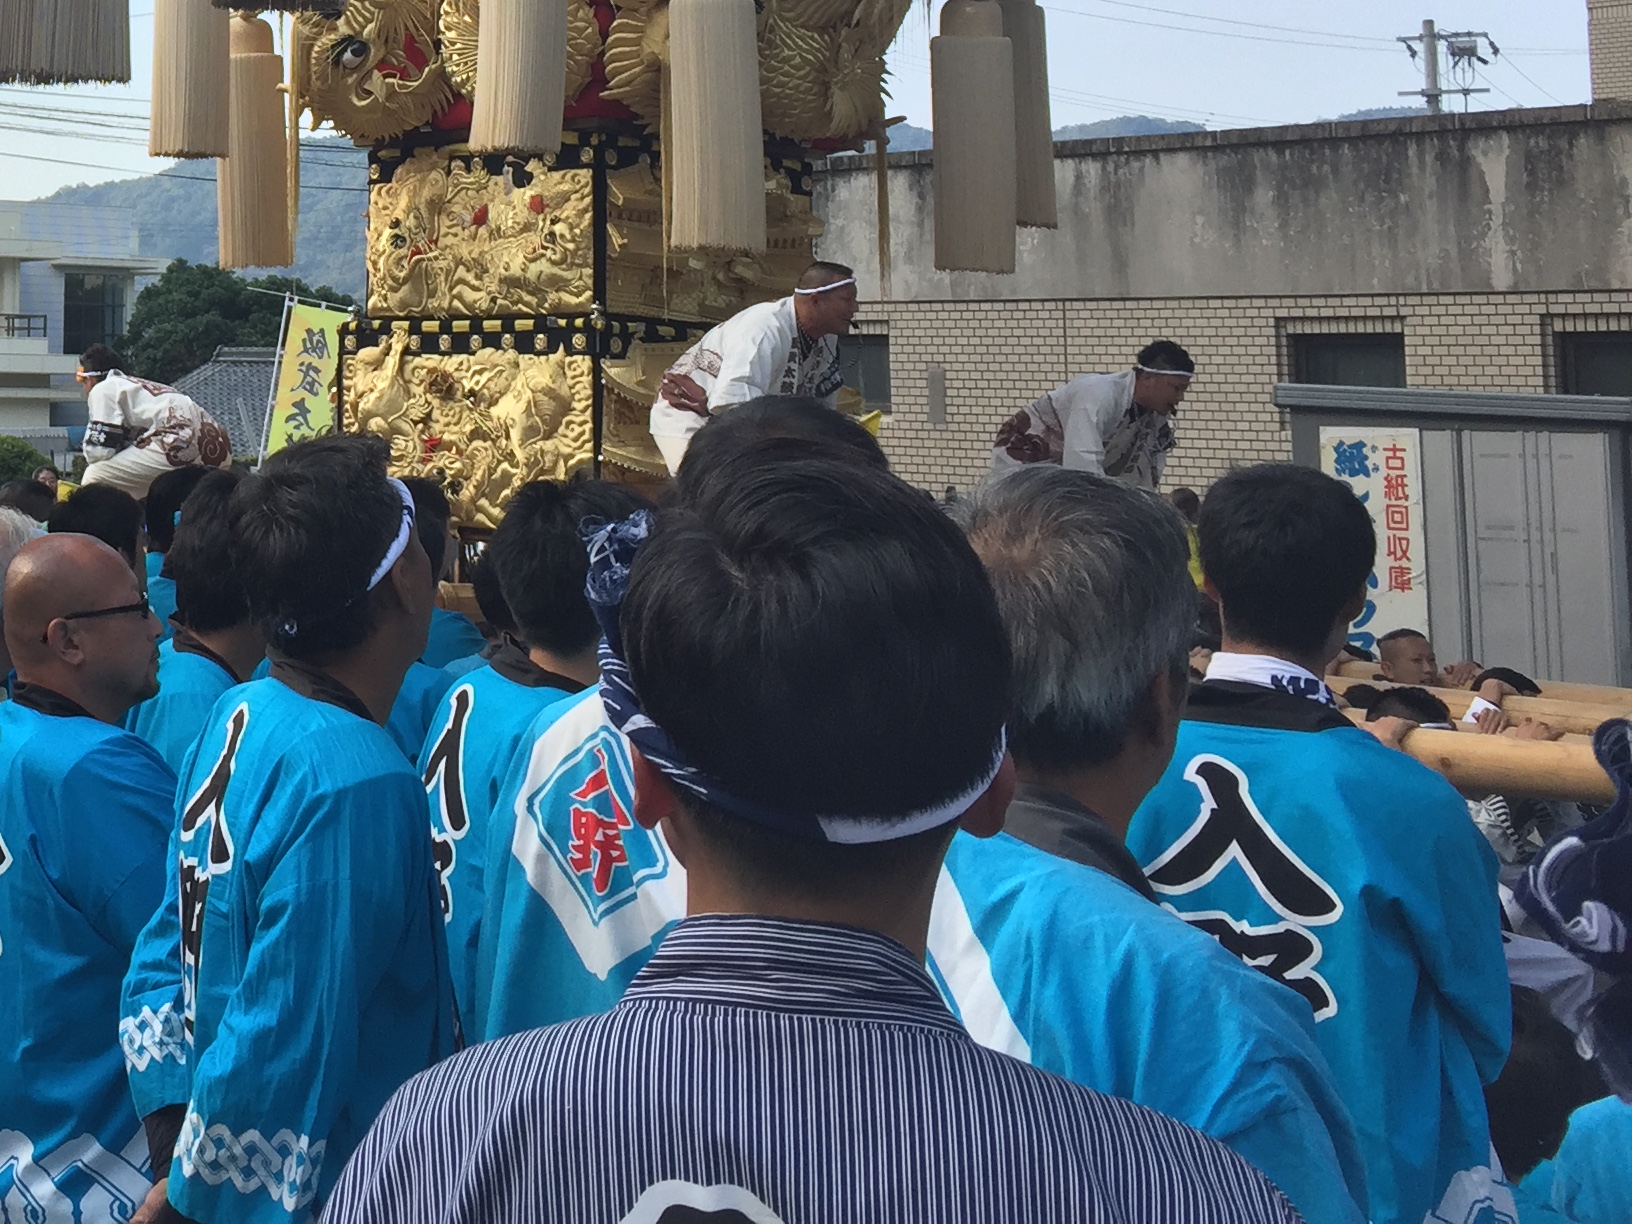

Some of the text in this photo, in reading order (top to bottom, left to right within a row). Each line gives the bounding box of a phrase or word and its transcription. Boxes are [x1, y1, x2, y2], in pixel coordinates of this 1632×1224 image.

[1381, 443, 1414, 594] 古紙回収庫
[567, 744, 634, 896] 入野
